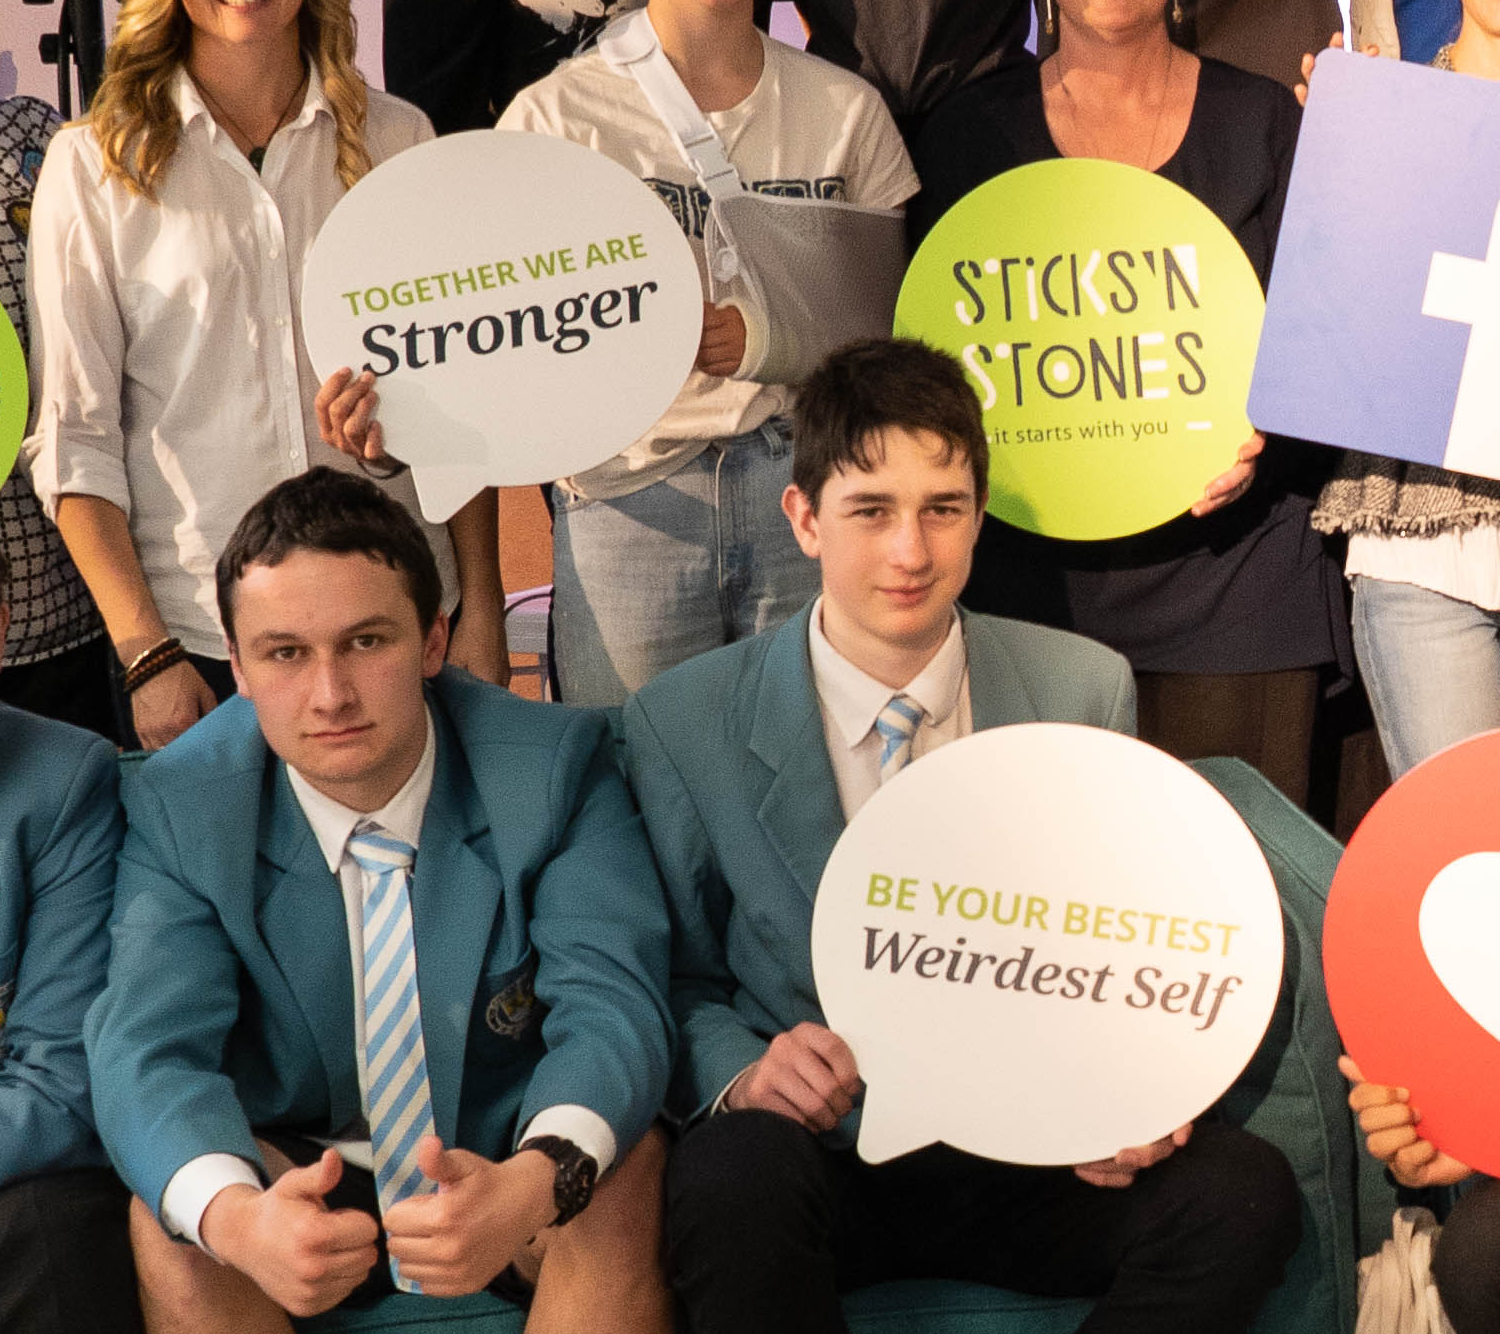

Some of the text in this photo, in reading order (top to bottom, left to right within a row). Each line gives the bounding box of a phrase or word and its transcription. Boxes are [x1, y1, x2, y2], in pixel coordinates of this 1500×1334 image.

[342, 233, 648, 316] TOGETHER WE ARE
[362, 280, 658, 377] Stronger
[962, 332, 1206, 412] STONES
[995, 419, 1169, 445] it starts with you
[866, 873, 1241, 958] BE YOUR BESTEST
[862, 925, 1244, 1032] Weirdest Self
